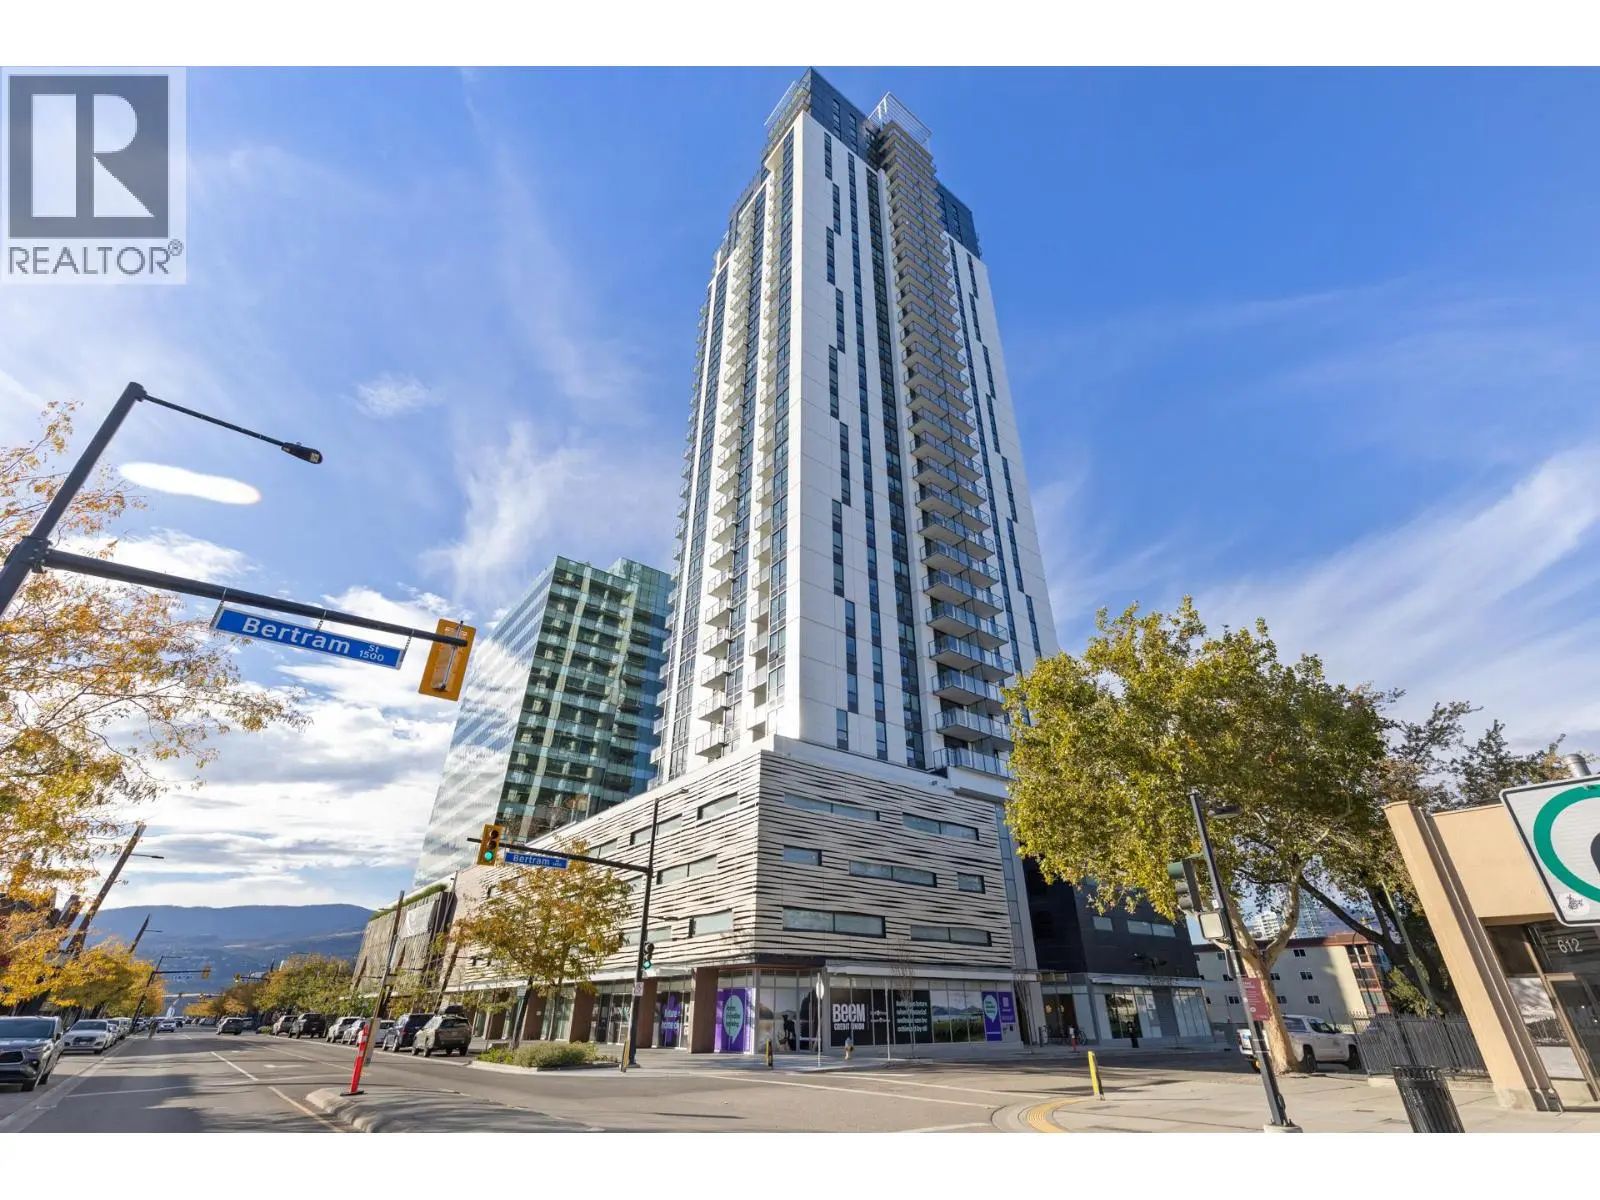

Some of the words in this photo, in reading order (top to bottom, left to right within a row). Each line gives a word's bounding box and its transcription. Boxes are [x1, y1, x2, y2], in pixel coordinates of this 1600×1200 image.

[241, 616, 351, 655] Bertram
[368, 644, 379, 654] St
[359, 650, 385, 662] 1500
[512, 854, 551, 866] Bertram
[1557, 937, 1584, 954] 612
